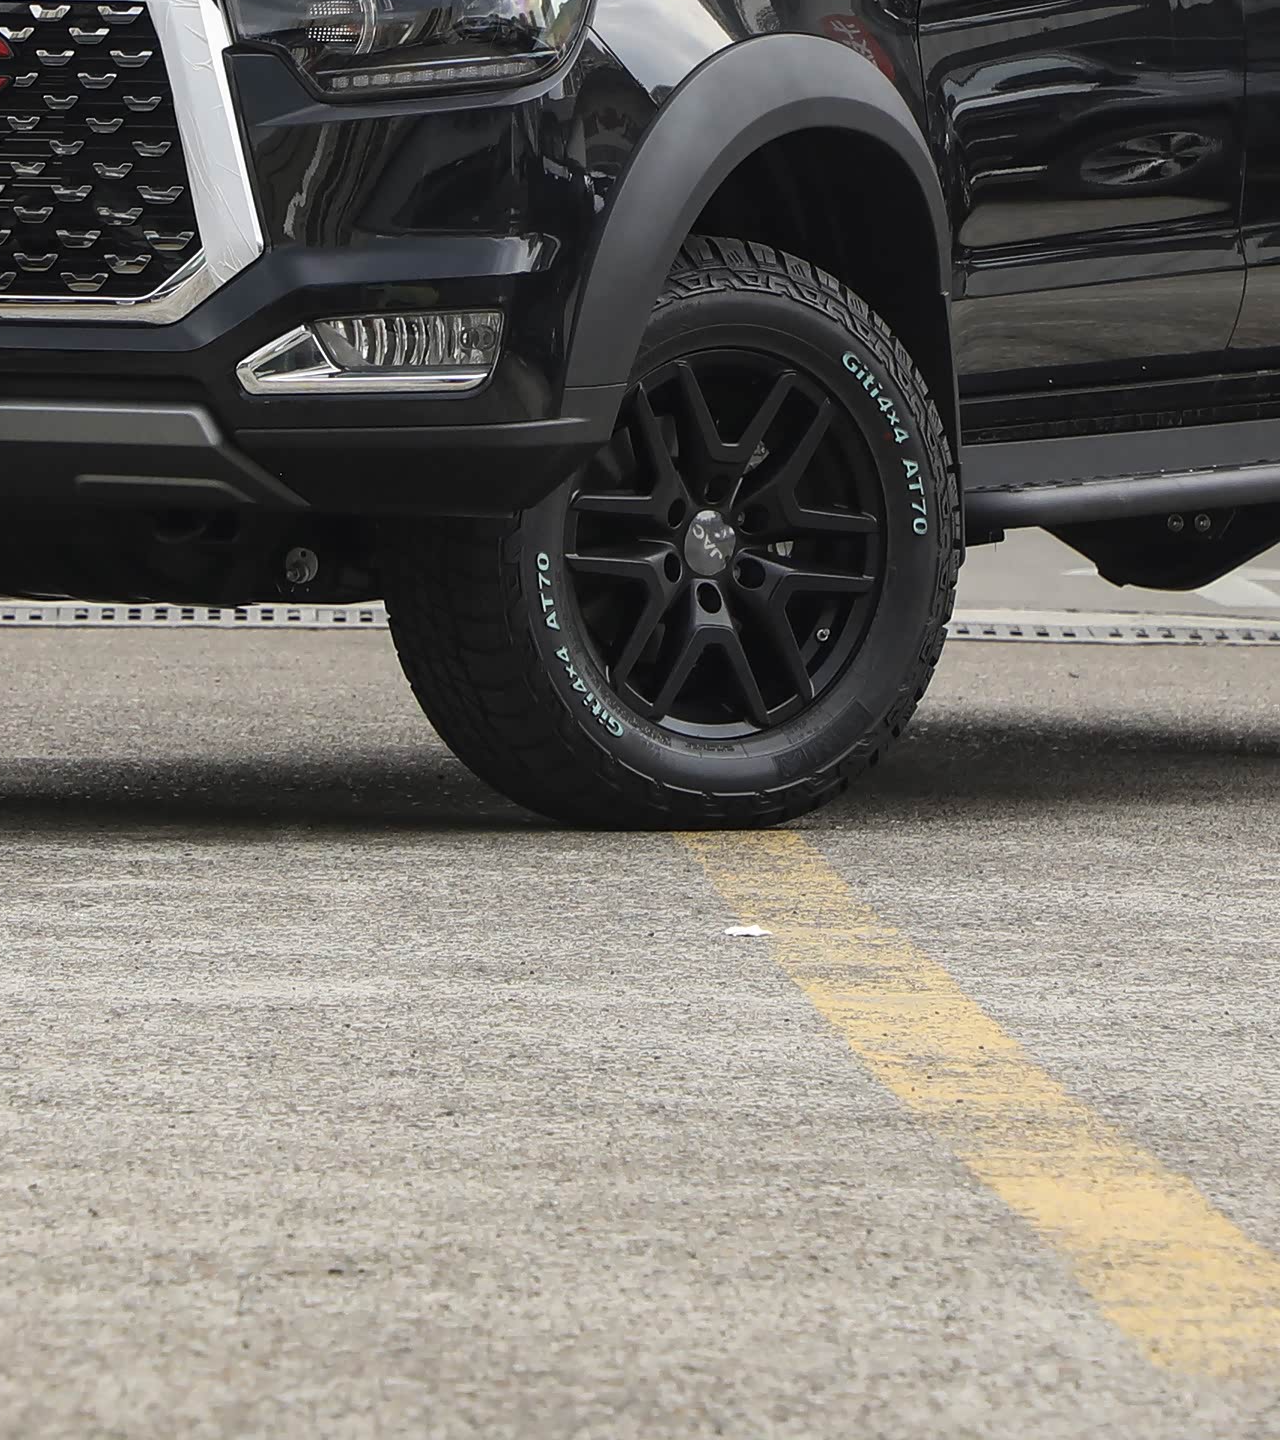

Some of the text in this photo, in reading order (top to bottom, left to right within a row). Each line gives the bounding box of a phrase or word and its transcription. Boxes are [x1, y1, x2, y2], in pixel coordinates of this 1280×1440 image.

[841, 350, 928, 536] Giti4x4 AT70
[691, 523, 723, 560] JAC
[537, 552, 625, 737] Giti4x4 AT70
